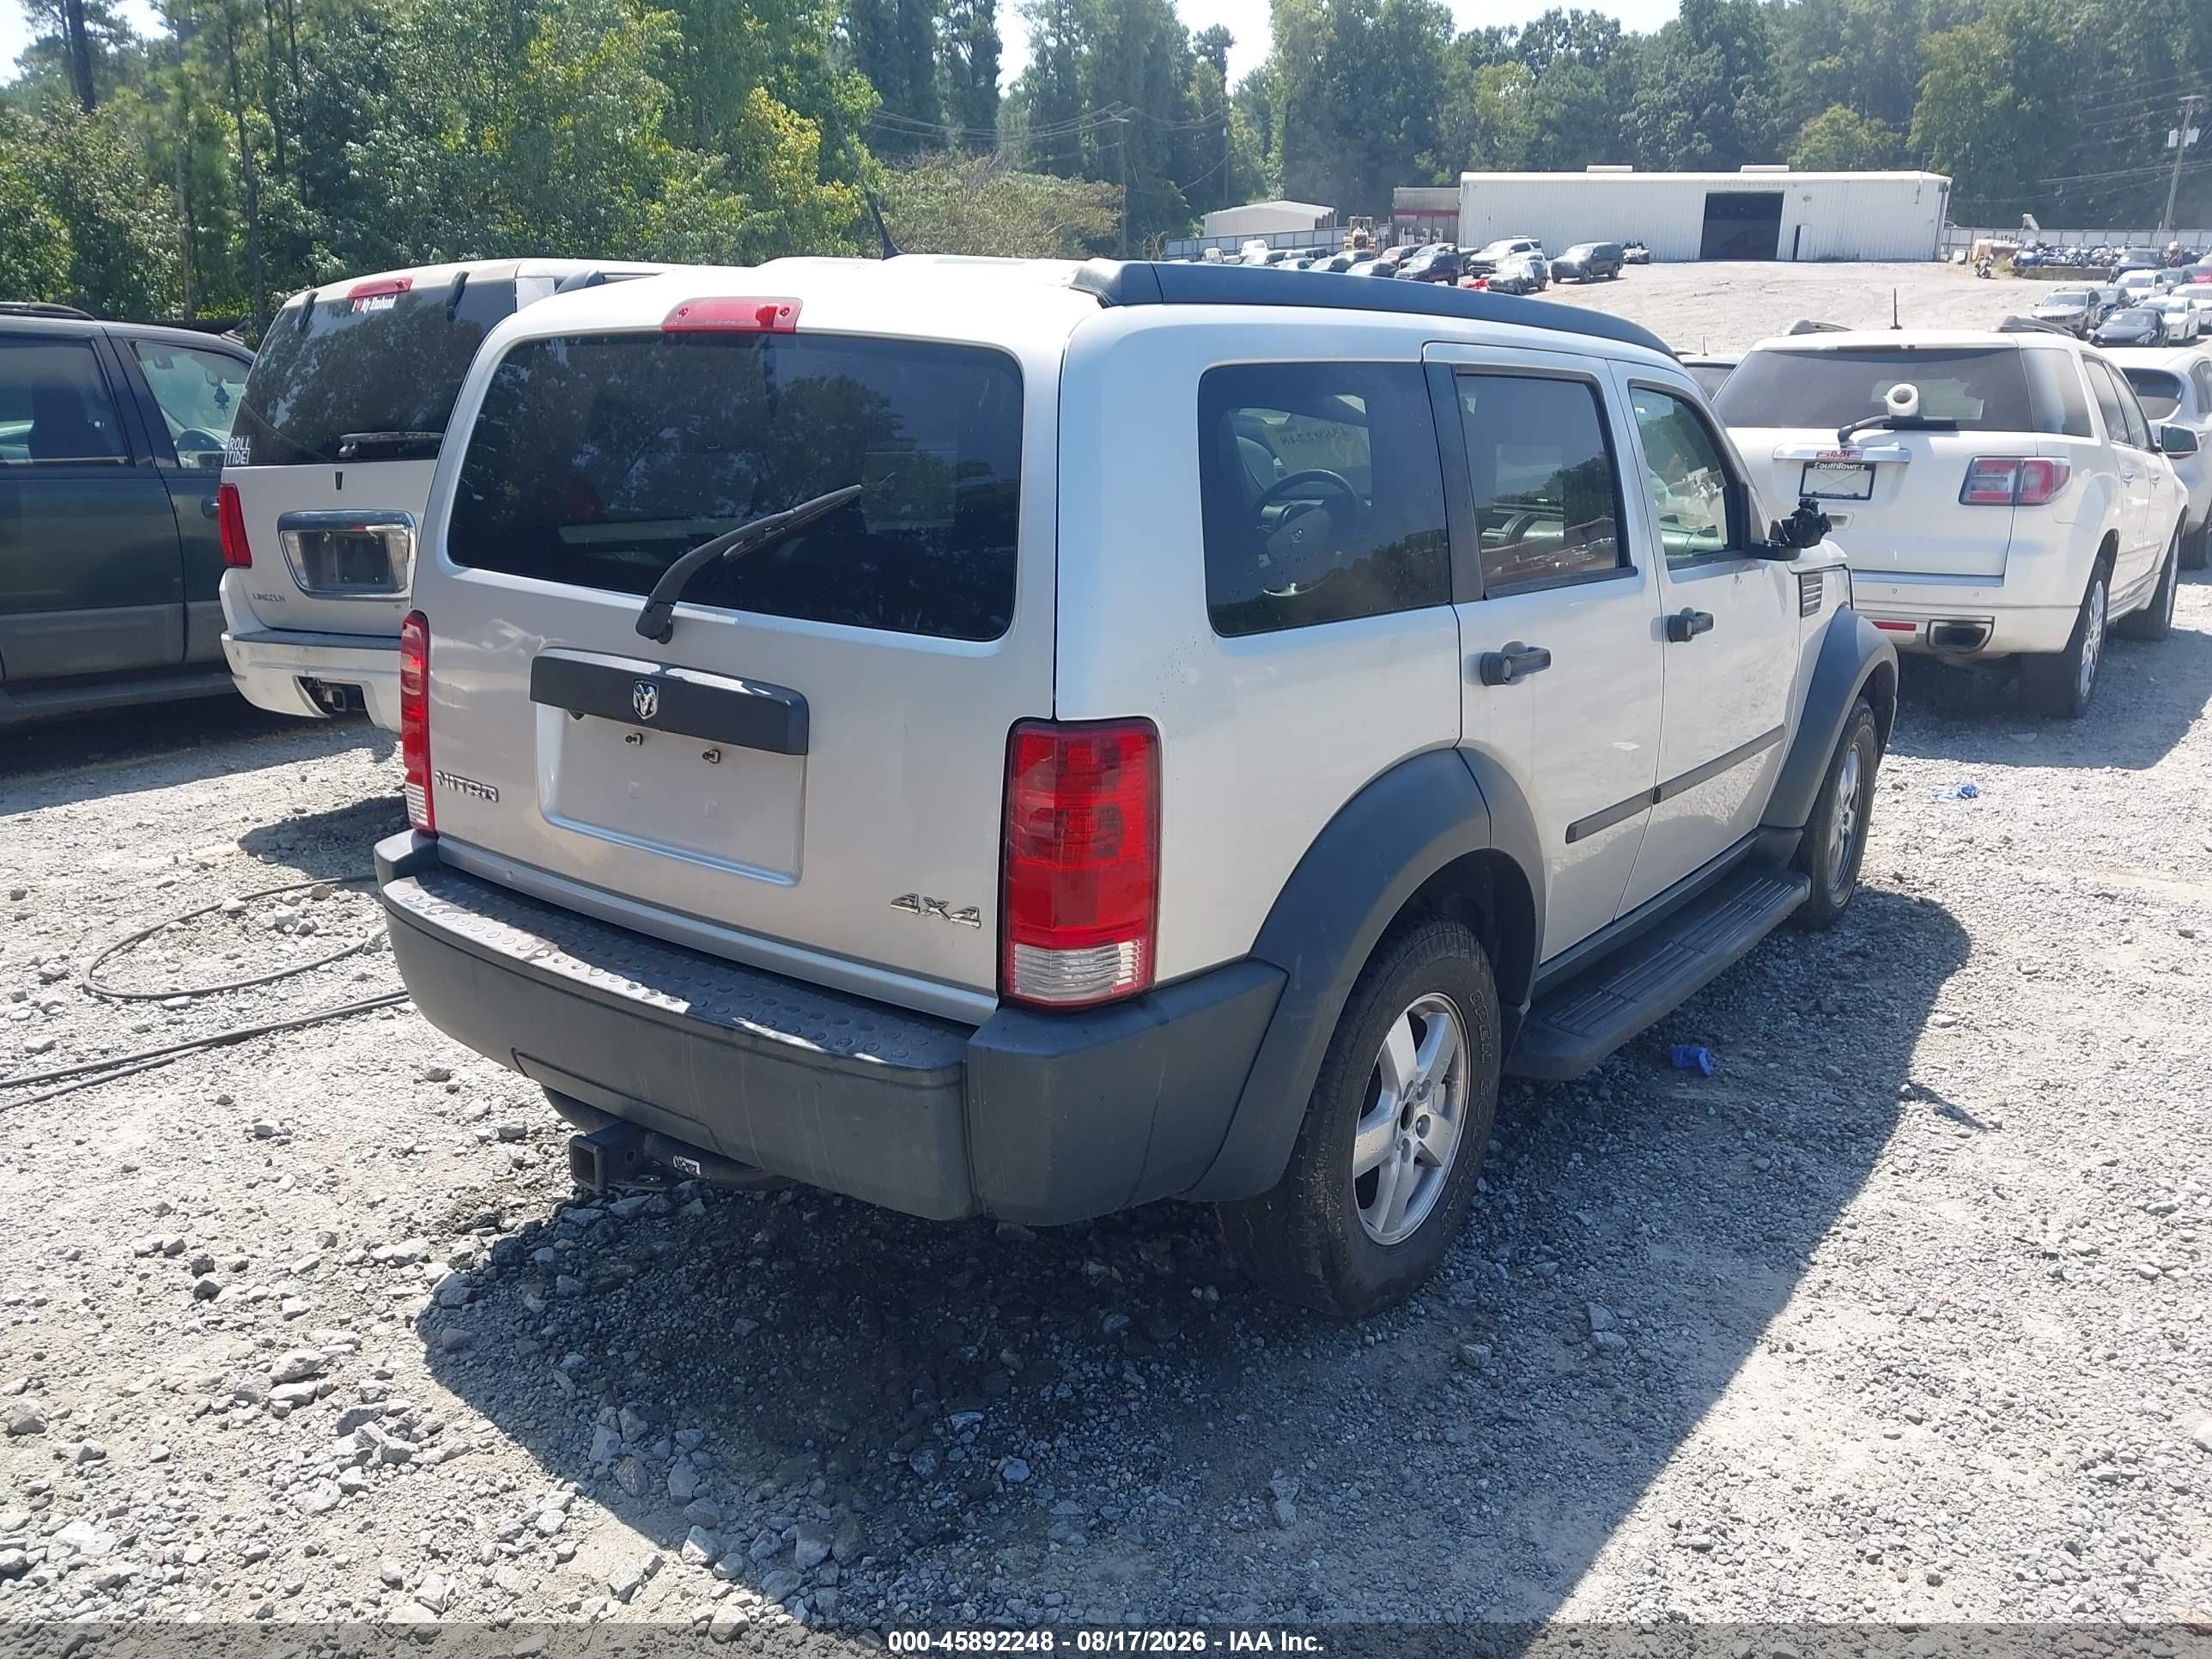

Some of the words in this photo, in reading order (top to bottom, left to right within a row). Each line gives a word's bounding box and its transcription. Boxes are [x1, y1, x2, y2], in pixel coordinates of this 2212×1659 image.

[228, 437, 250, 450] ROLL
[1816, 450, 1863, 459] GMC
[434, 769, 499, 803] NITRO
